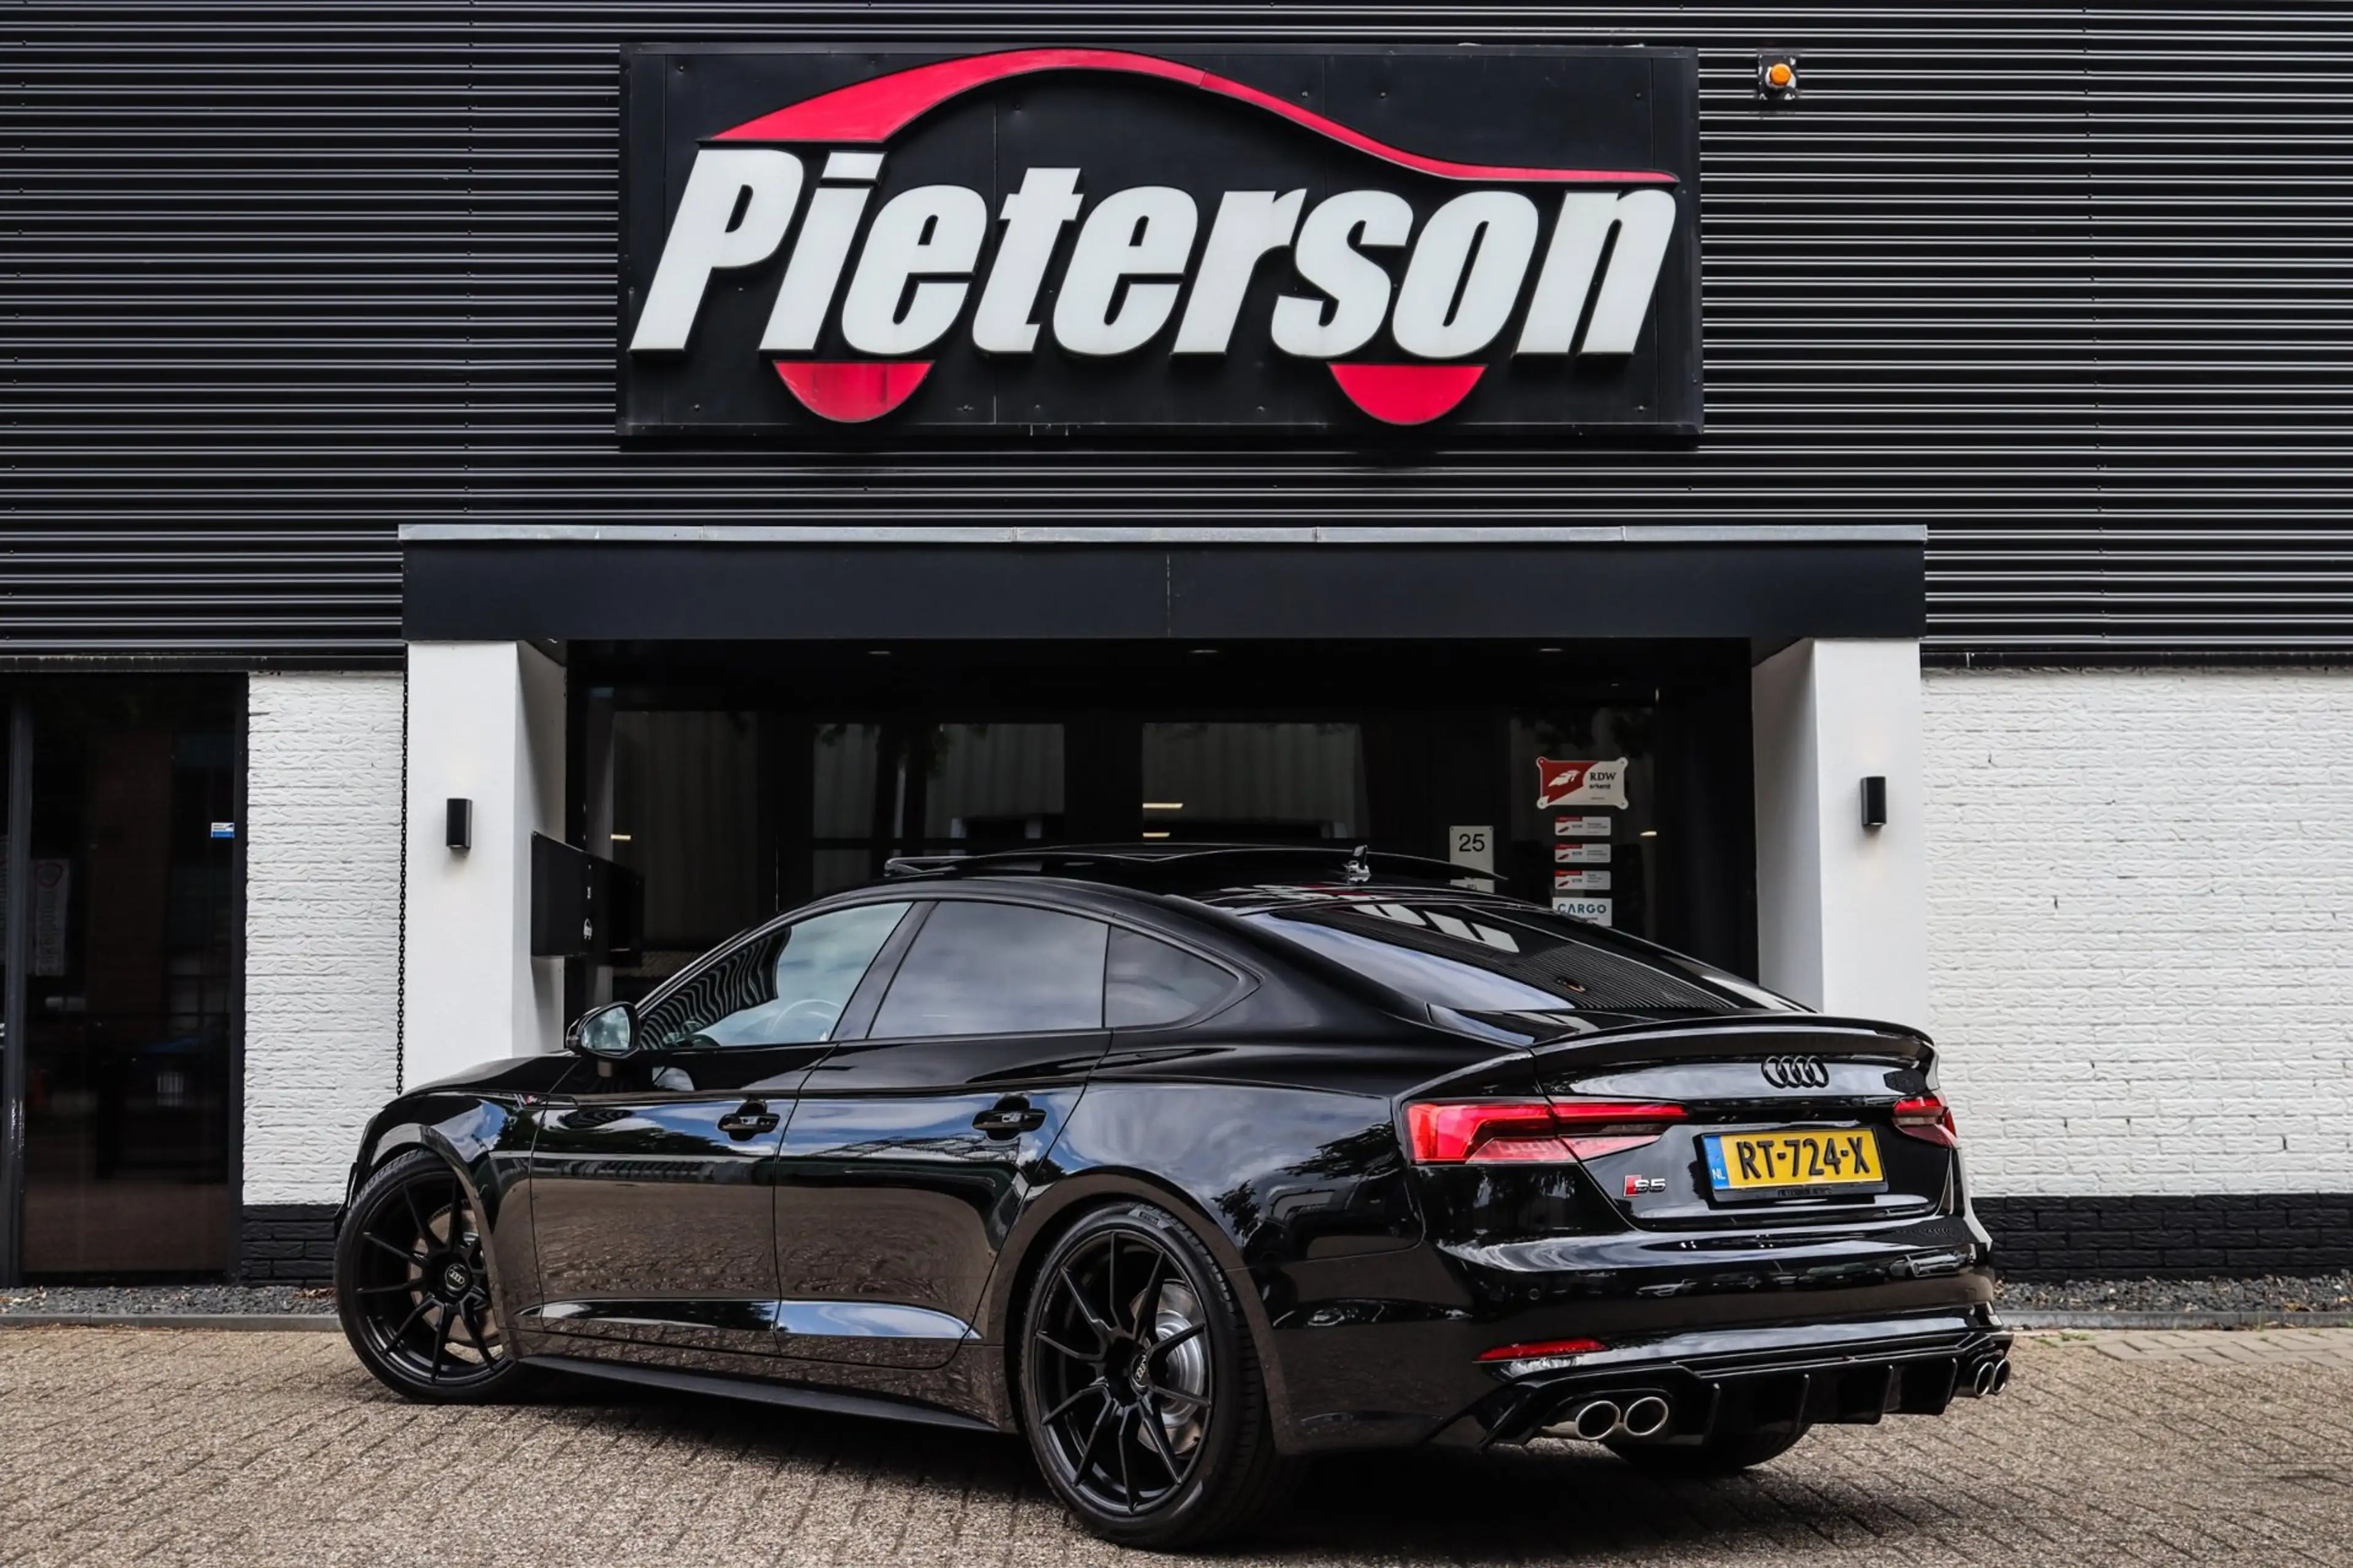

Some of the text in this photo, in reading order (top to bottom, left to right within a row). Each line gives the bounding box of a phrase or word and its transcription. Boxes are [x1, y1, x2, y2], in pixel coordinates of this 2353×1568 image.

[629, 148, 1678, 359] Pieterson
[1590, 772, 1617, 781] RDW
[1458, 833, 1485, 852] 25
[1557, 903, 1607, 914] CARGO
[1736, 1137, 1870, 1180] RT-724-X
[1711, 1168, 1726, 1180] NL
[1634, 1178, 1667, 1193] S5
